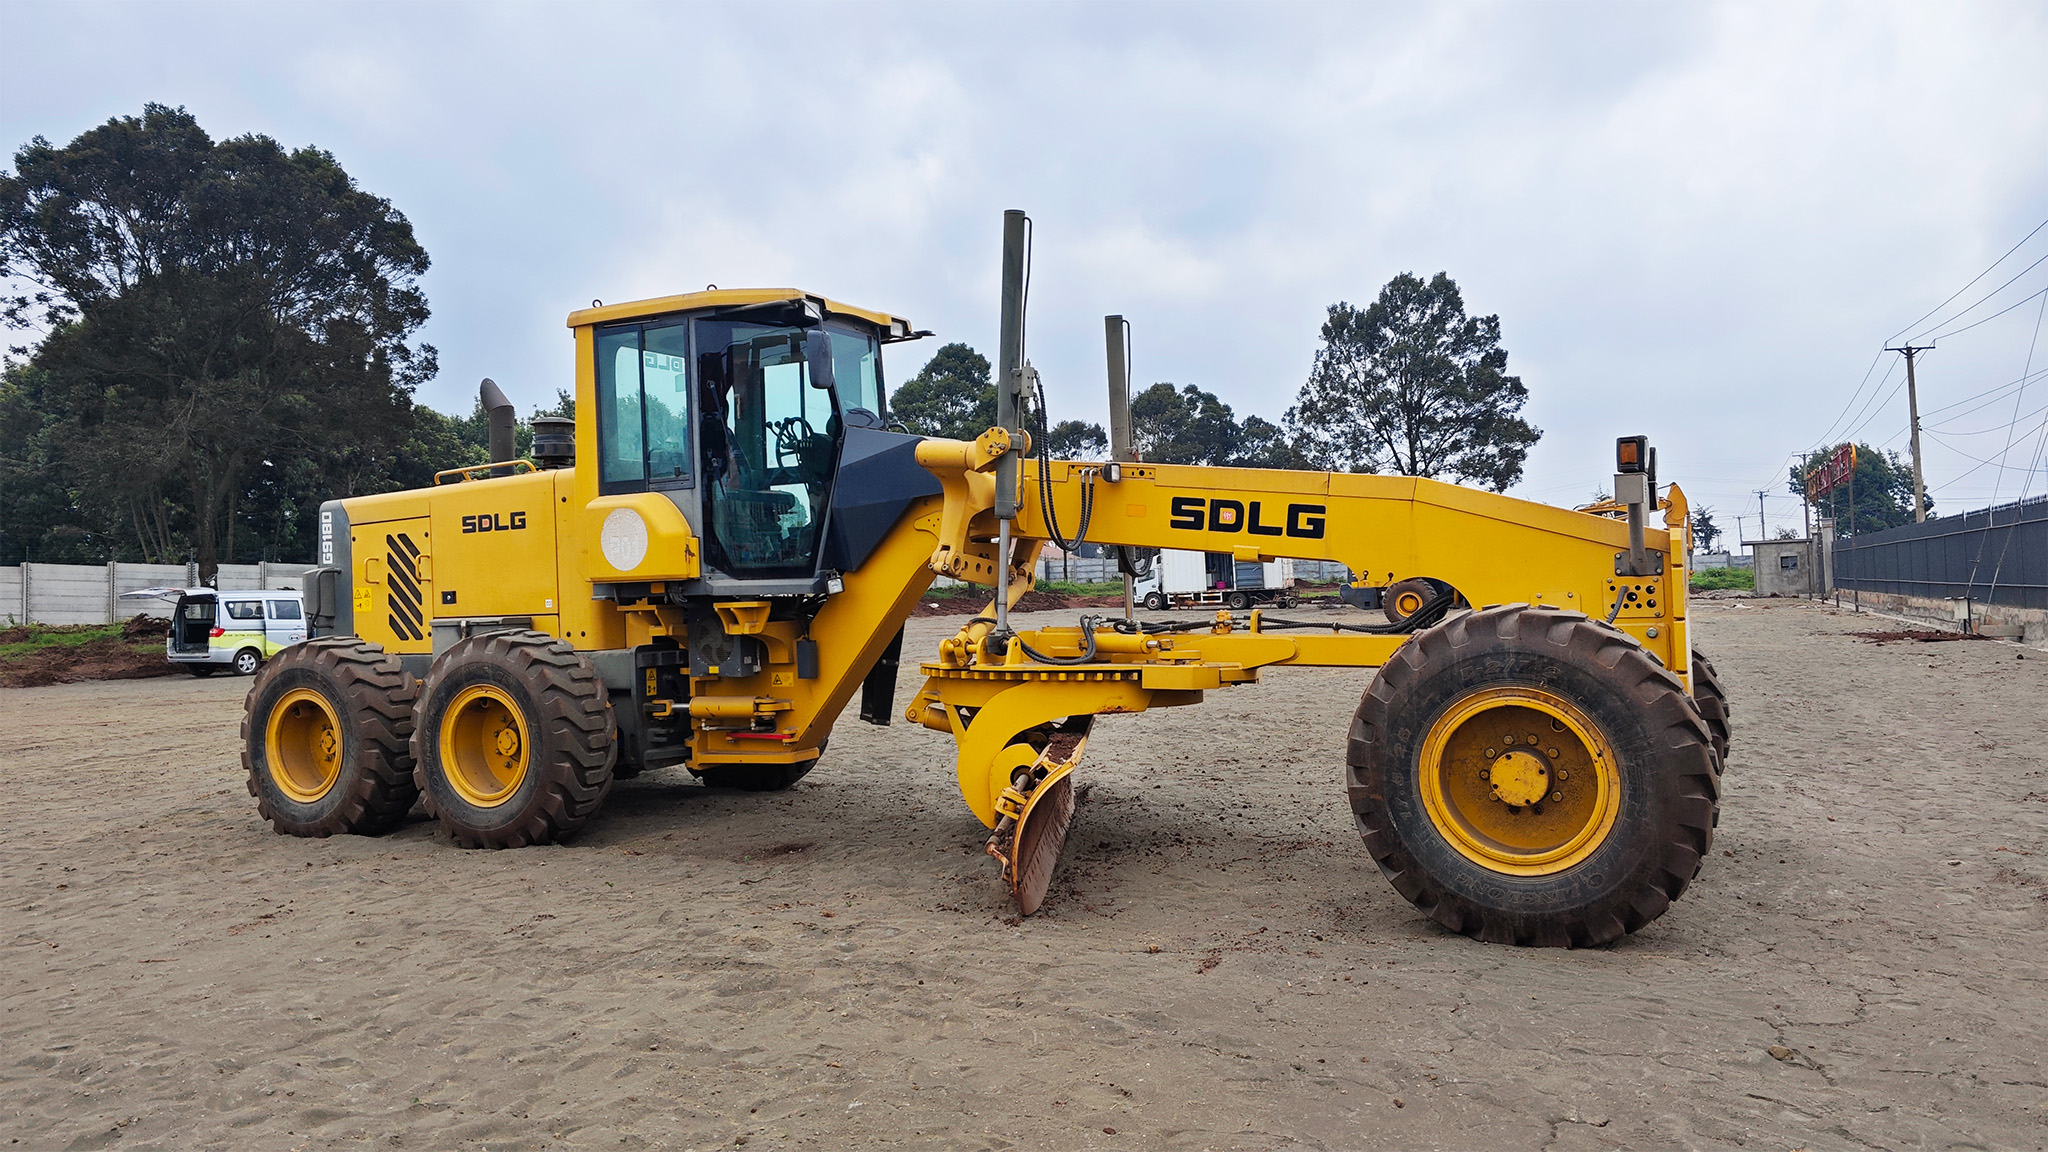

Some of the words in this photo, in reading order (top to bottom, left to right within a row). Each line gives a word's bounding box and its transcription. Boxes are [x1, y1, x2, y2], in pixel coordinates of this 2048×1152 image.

[321, 511, 333, 565] G9180
[461, 511, 527, 534] SDLG
[1170, 496, 1326, 540] SDLG
